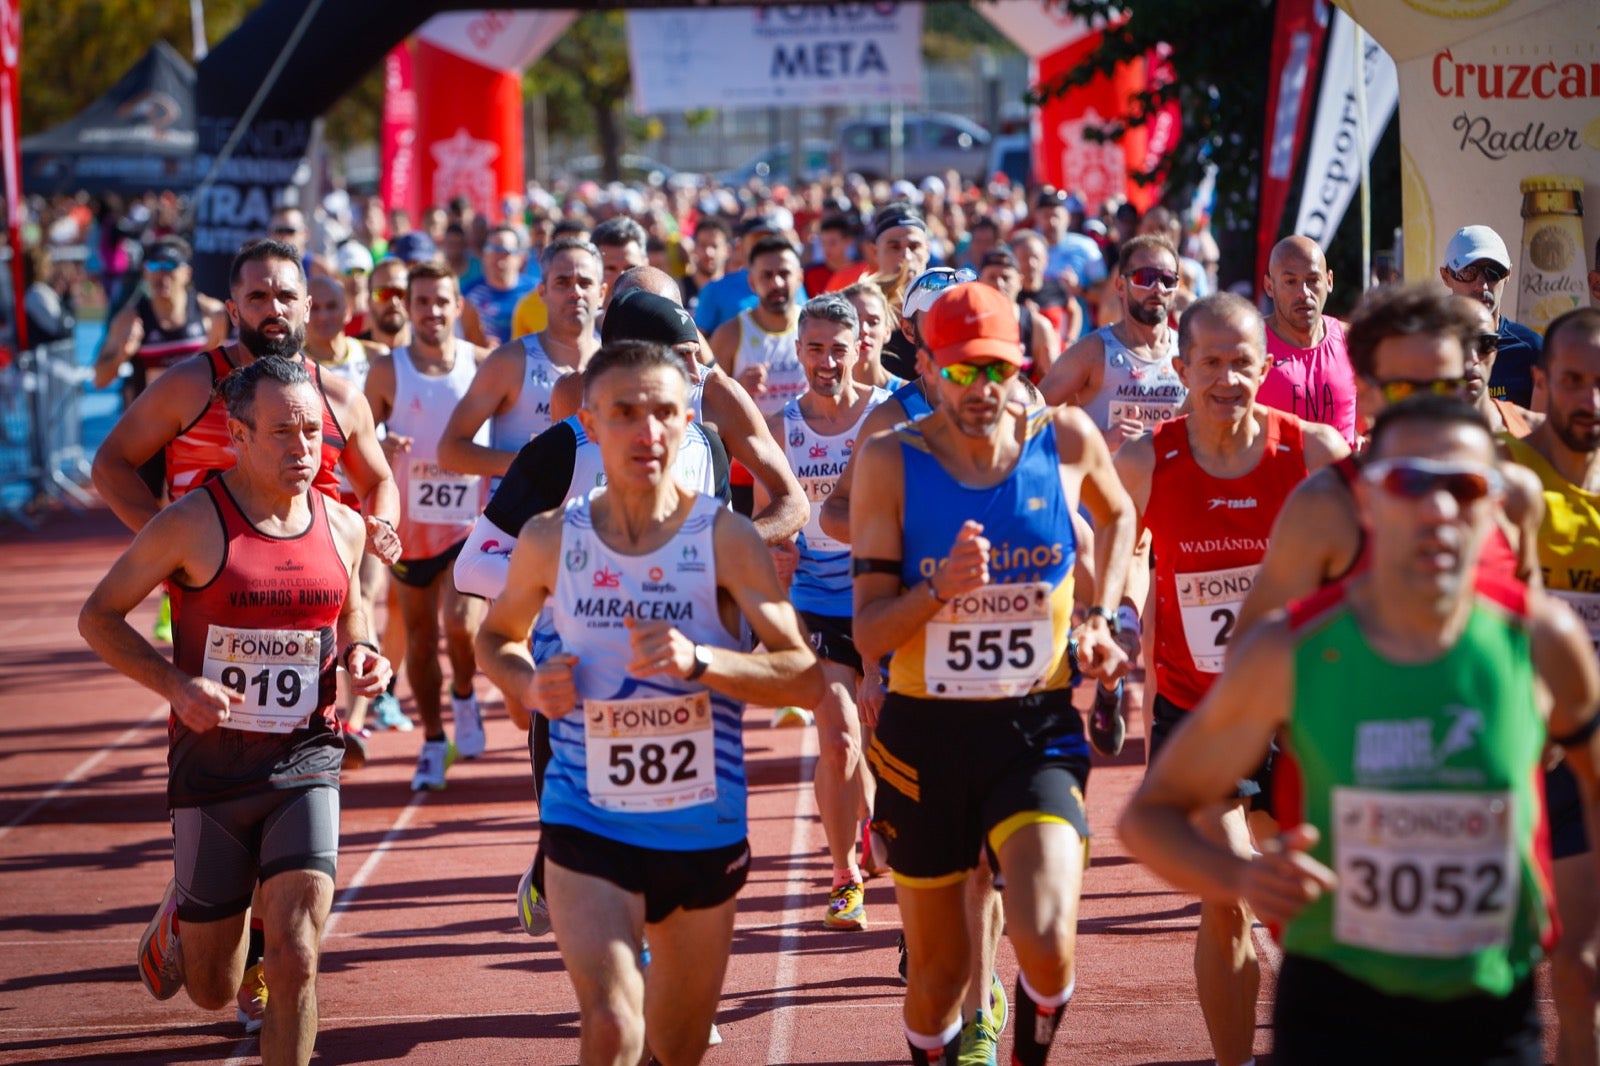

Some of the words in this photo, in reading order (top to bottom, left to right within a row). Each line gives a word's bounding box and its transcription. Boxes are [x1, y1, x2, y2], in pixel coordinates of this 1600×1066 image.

[770, 41, 888, 79] META
[1452, 110, 1582, 160] Radler
[1116, 384, 1186, 397] MARACENA
[418, 483, 468, 507] 267
[1198, 575, 1255, 598] FOND
[229, 590, 293, 608] VAMPIROS
[574, 599, 694, 621] MARACENA
[953, 595, 1029, 615] FONDO
[231, 638, 300, 657] FONDO
[946, 628, 1035, 672] 555
[221, 666, 301, 708] 919
[612, 707, 691, 729] FONDO
[608, 739, 699, 788] 582
[1349, 858, 1506, 919] 3052
